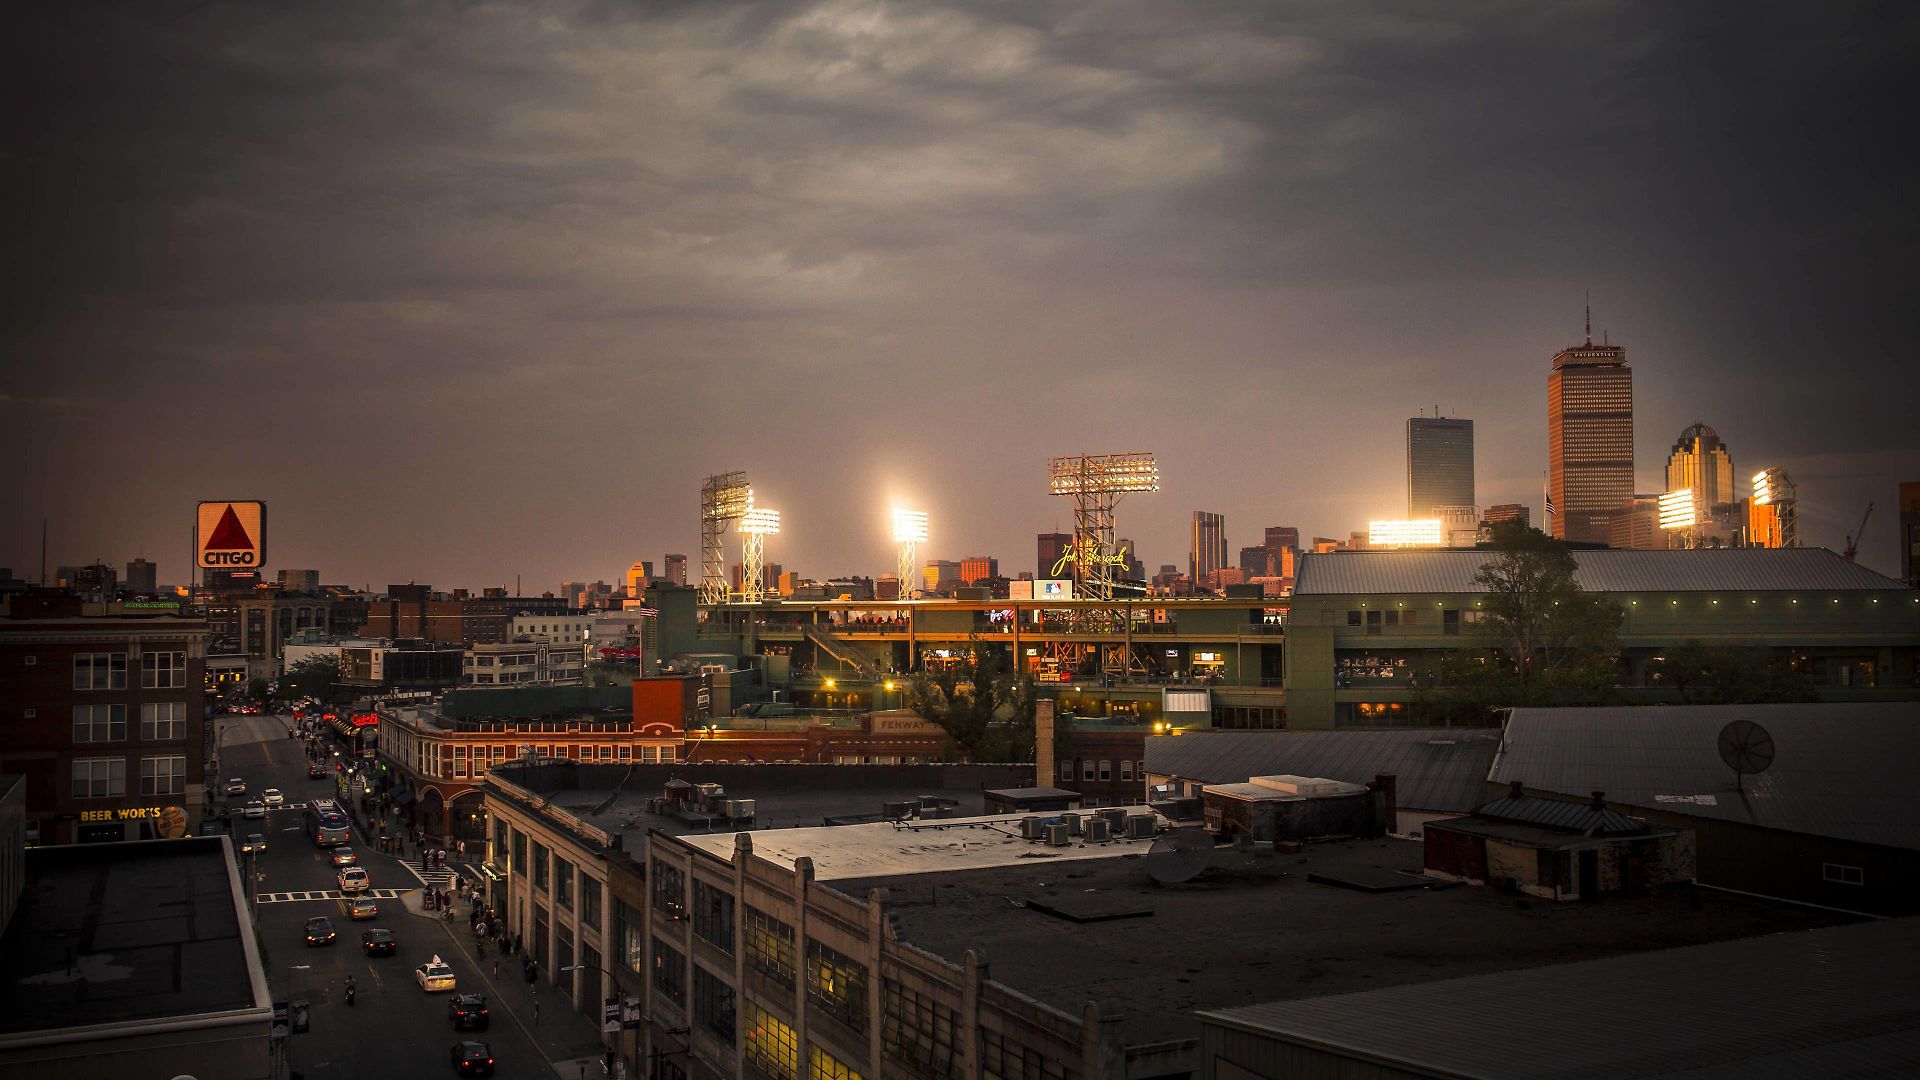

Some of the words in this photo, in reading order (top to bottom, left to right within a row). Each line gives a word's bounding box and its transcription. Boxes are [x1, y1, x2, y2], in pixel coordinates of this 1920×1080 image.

[204, 551, 254, 564] CITGO
[881, 720, 926, 729] FENWAY
[80, 810, 112, 822] BEER
